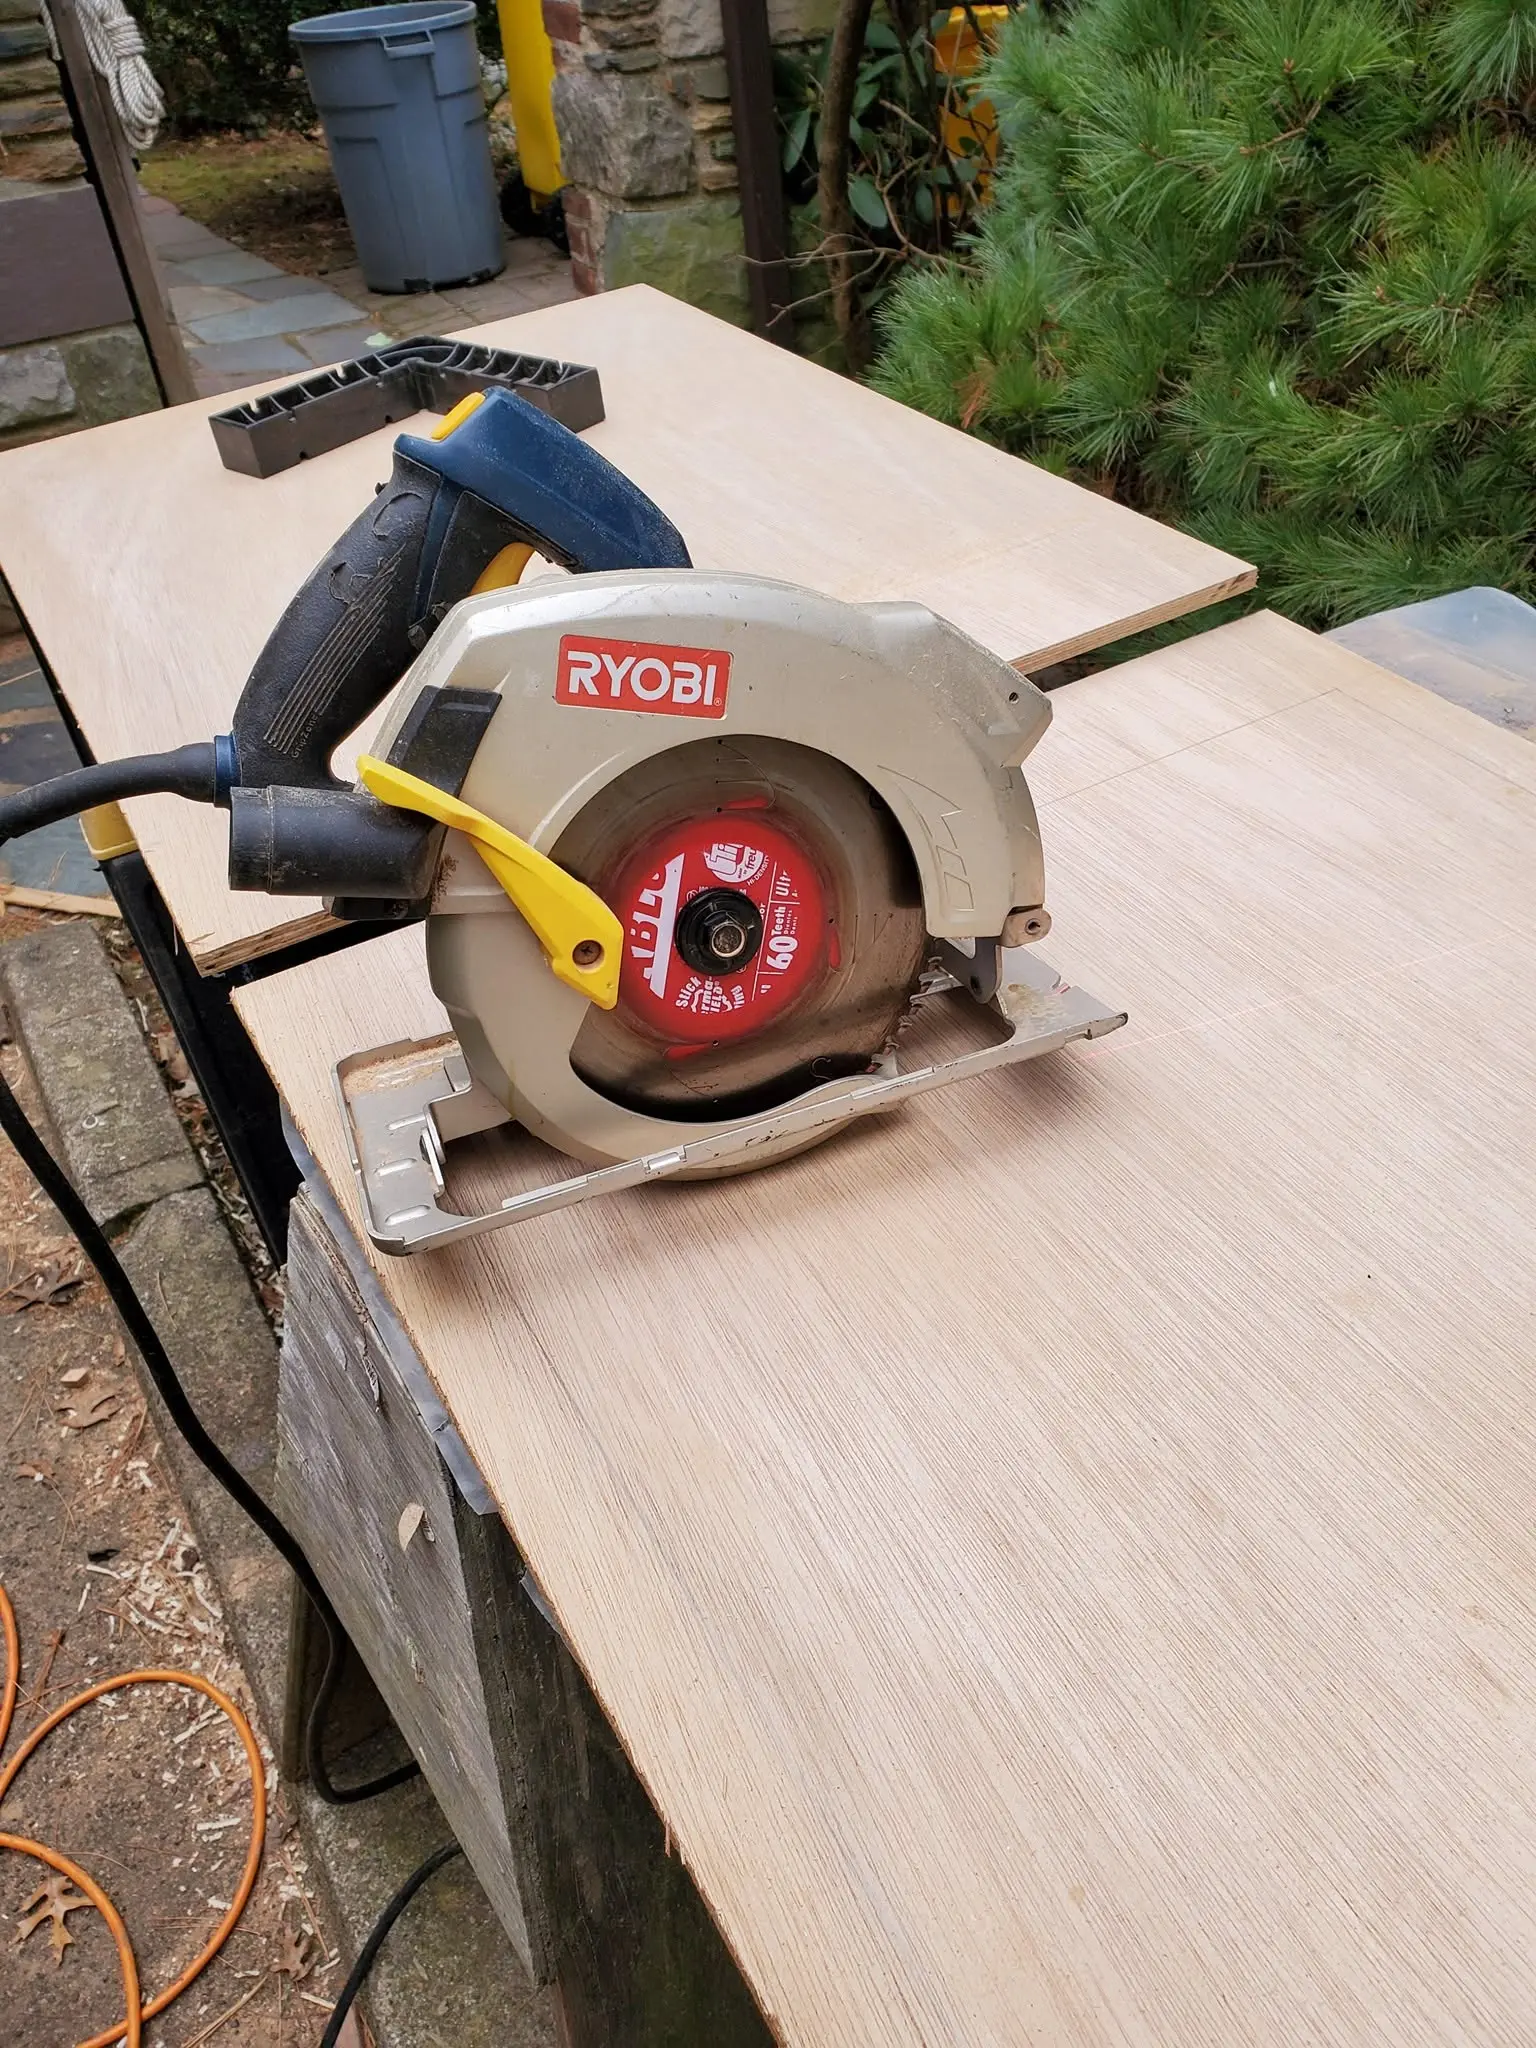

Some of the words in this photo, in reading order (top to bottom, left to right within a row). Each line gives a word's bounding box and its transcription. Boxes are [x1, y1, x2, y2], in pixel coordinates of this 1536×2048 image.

[567, 650, 718, 706] RYOBI
[771, 906, 787, 936] Teeth
[766, 936, 798, 970] 60
